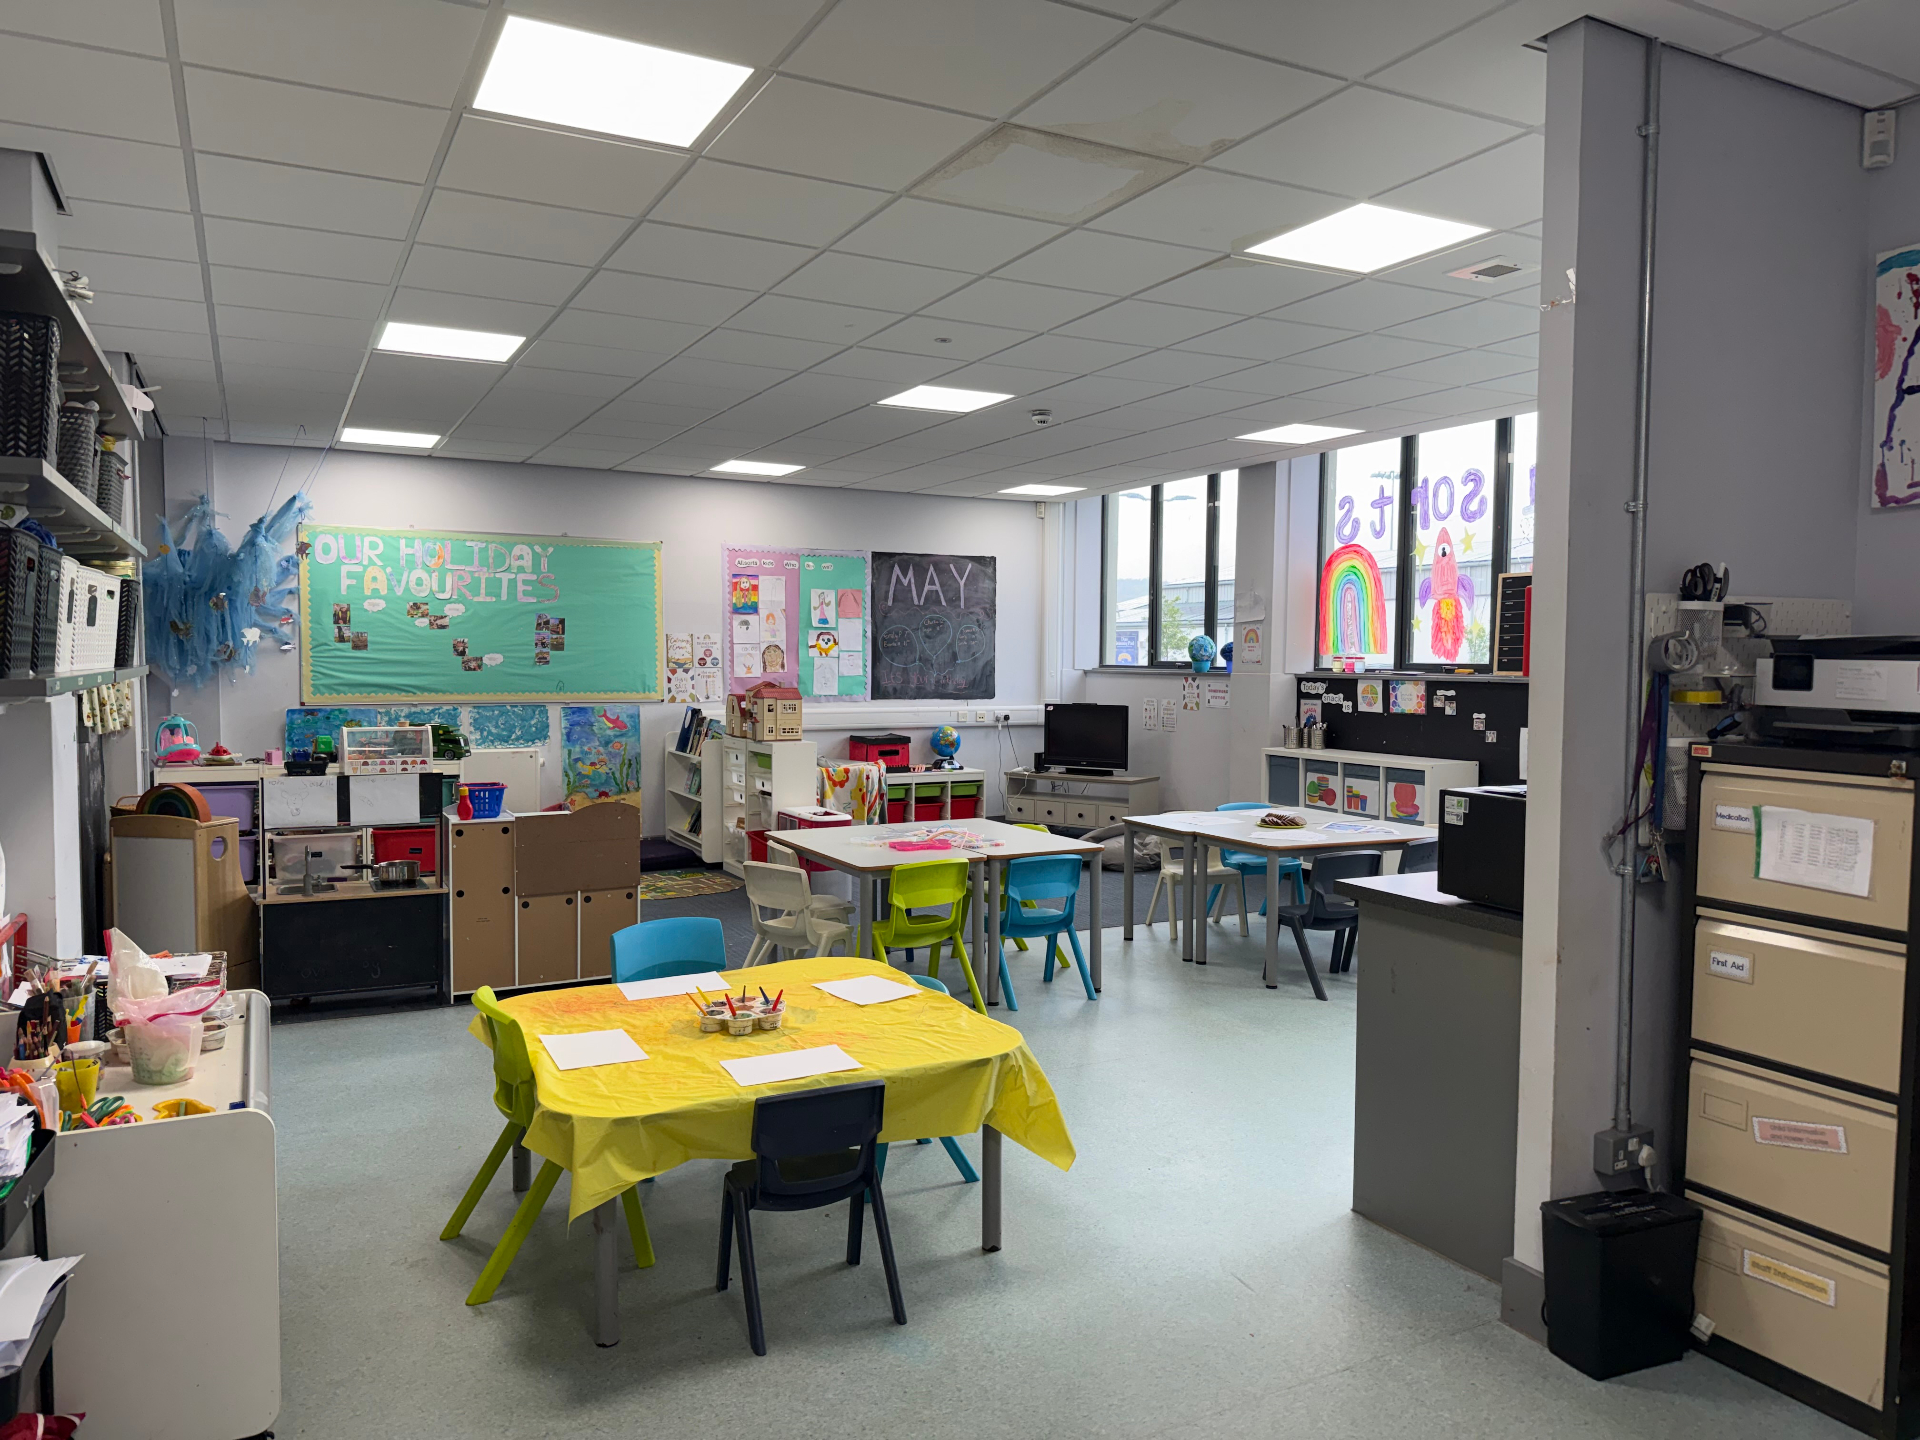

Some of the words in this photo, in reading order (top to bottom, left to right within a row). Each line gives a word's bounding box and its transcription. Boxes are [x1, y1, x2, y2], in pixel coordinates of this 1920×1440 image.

[314, 533, 384, 566] OUR
[400, 537, 554, 573] HOLIDAY
[340, 565, 560, 603] FAVOURITES
[888, 563, 972, 609] MAY
[1303, 683, 1324, 692] Today's
[1716, 811, 1750, 822] Medication
[1712, 956, 1727, 967] First
[1731, 961, 1745, 972] Aid
